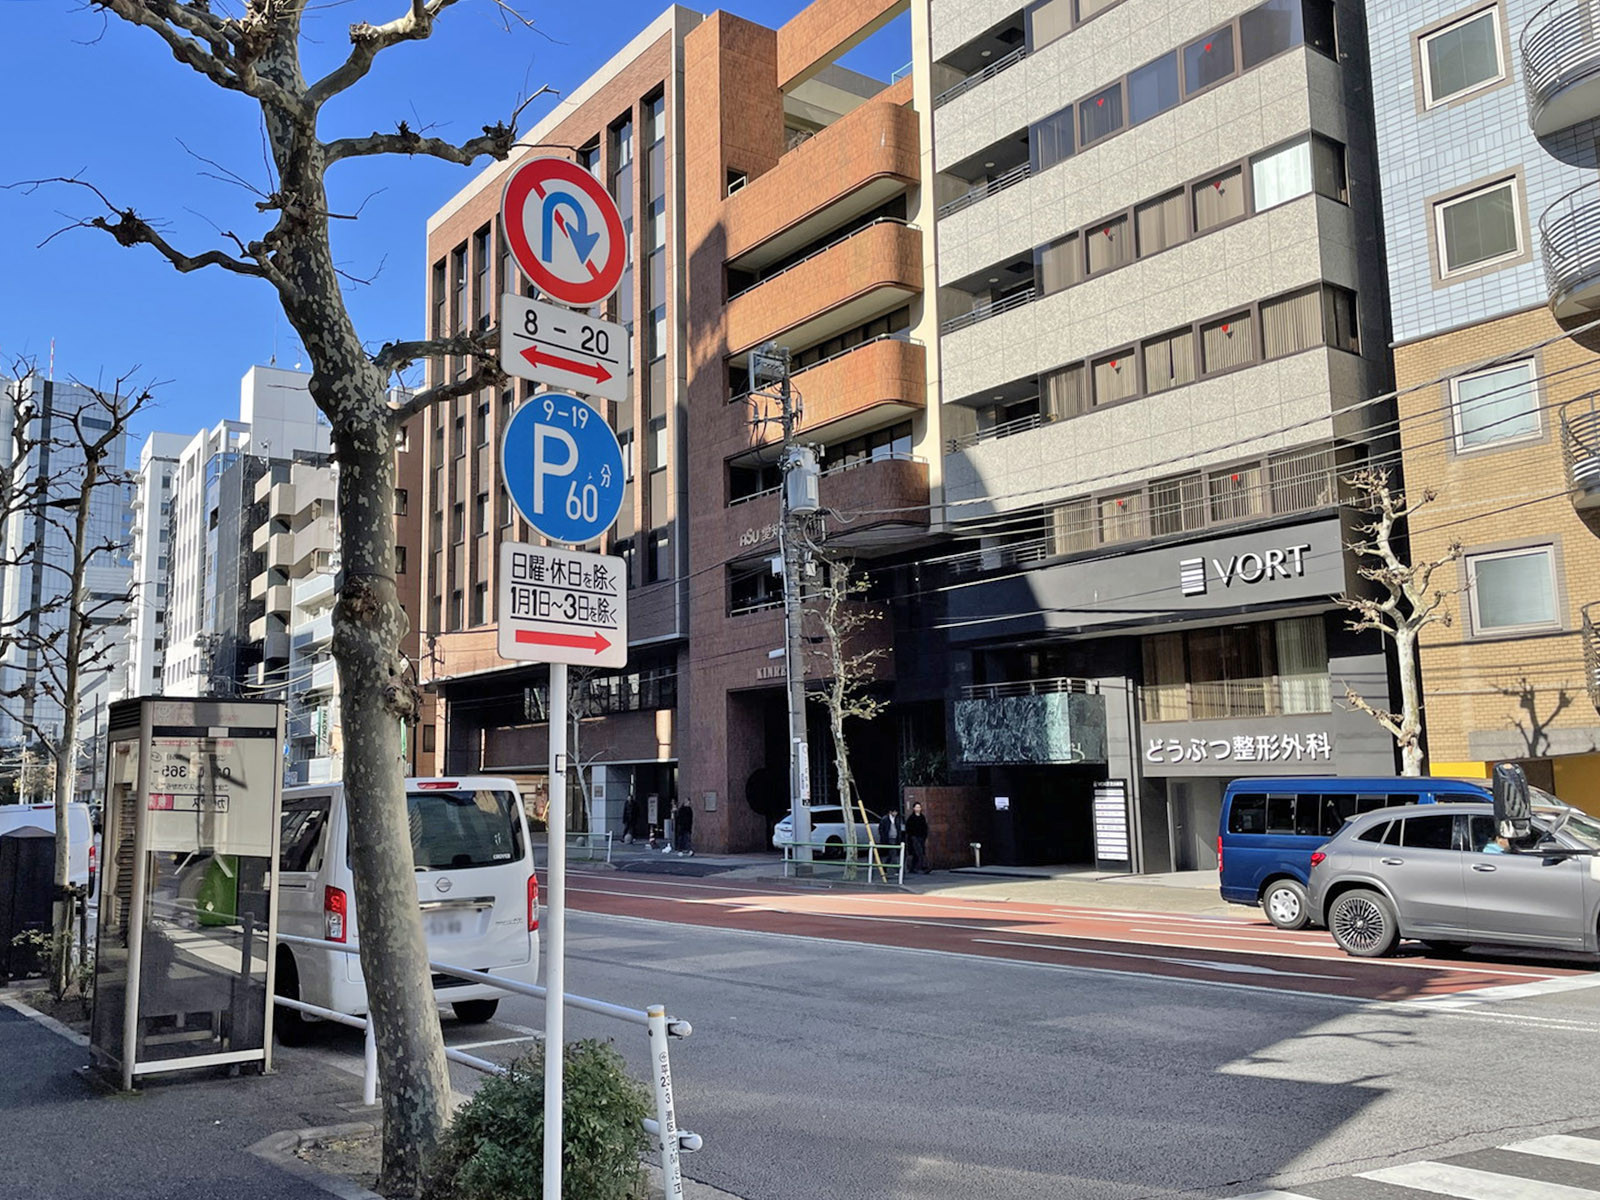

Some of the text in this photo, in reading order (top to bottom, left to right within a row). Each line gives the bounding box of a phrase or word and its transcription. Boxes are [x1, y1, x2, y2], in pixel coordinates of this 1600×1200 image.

[524, 309, 539, 336] 8
[580, 325, 609, 356] 20
[542, 399, 590, 430] 9-19
[533, 422, 579, 515] P
[565, 480, 599, 523] 60
[1212, 543, 1311, 588] VORT
[1145, 731, 1332, 764] どうぶつ整形外科
